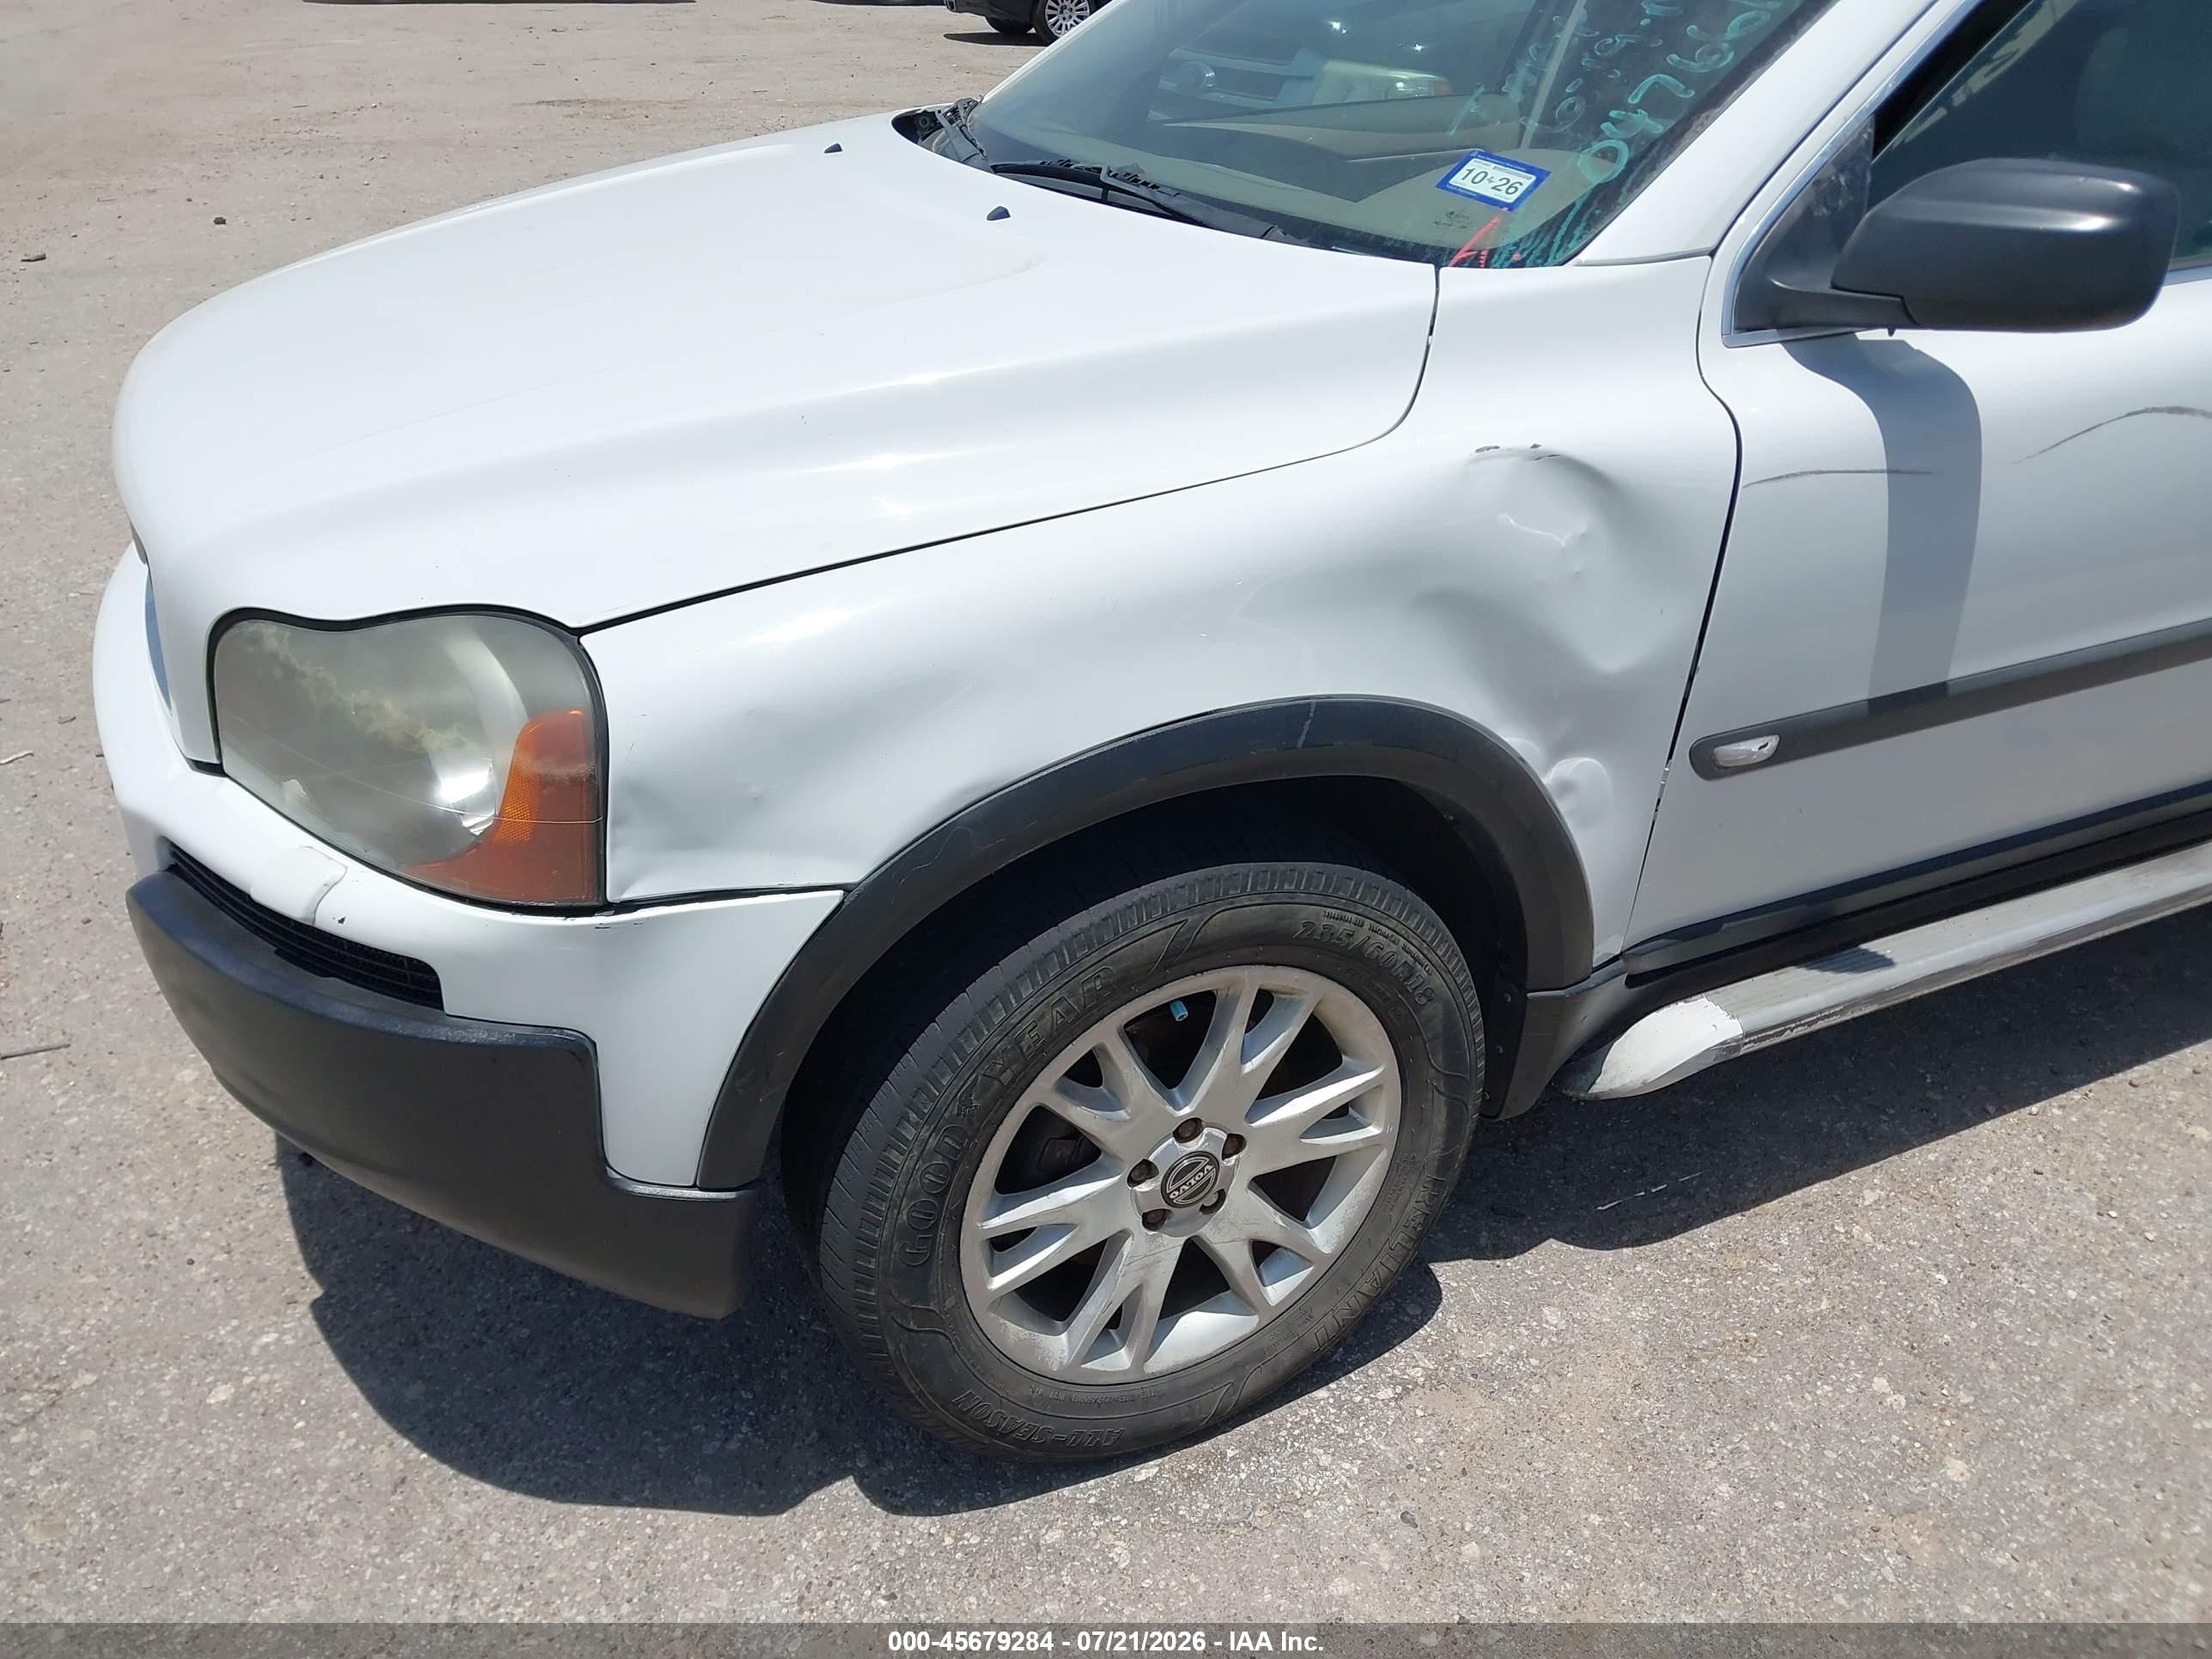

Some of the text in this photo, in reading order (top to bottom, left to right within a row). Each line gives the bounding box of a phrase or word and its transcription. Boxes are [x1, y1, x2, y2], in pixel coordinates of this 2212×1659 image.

[1461, 167, 1488, 185] 10
[1491, 177, 1523, 195] 26
[1169, 1164, 1214, 1199] VOLVO
[951, 1389, 1126, 1447] ALL-SEASON
